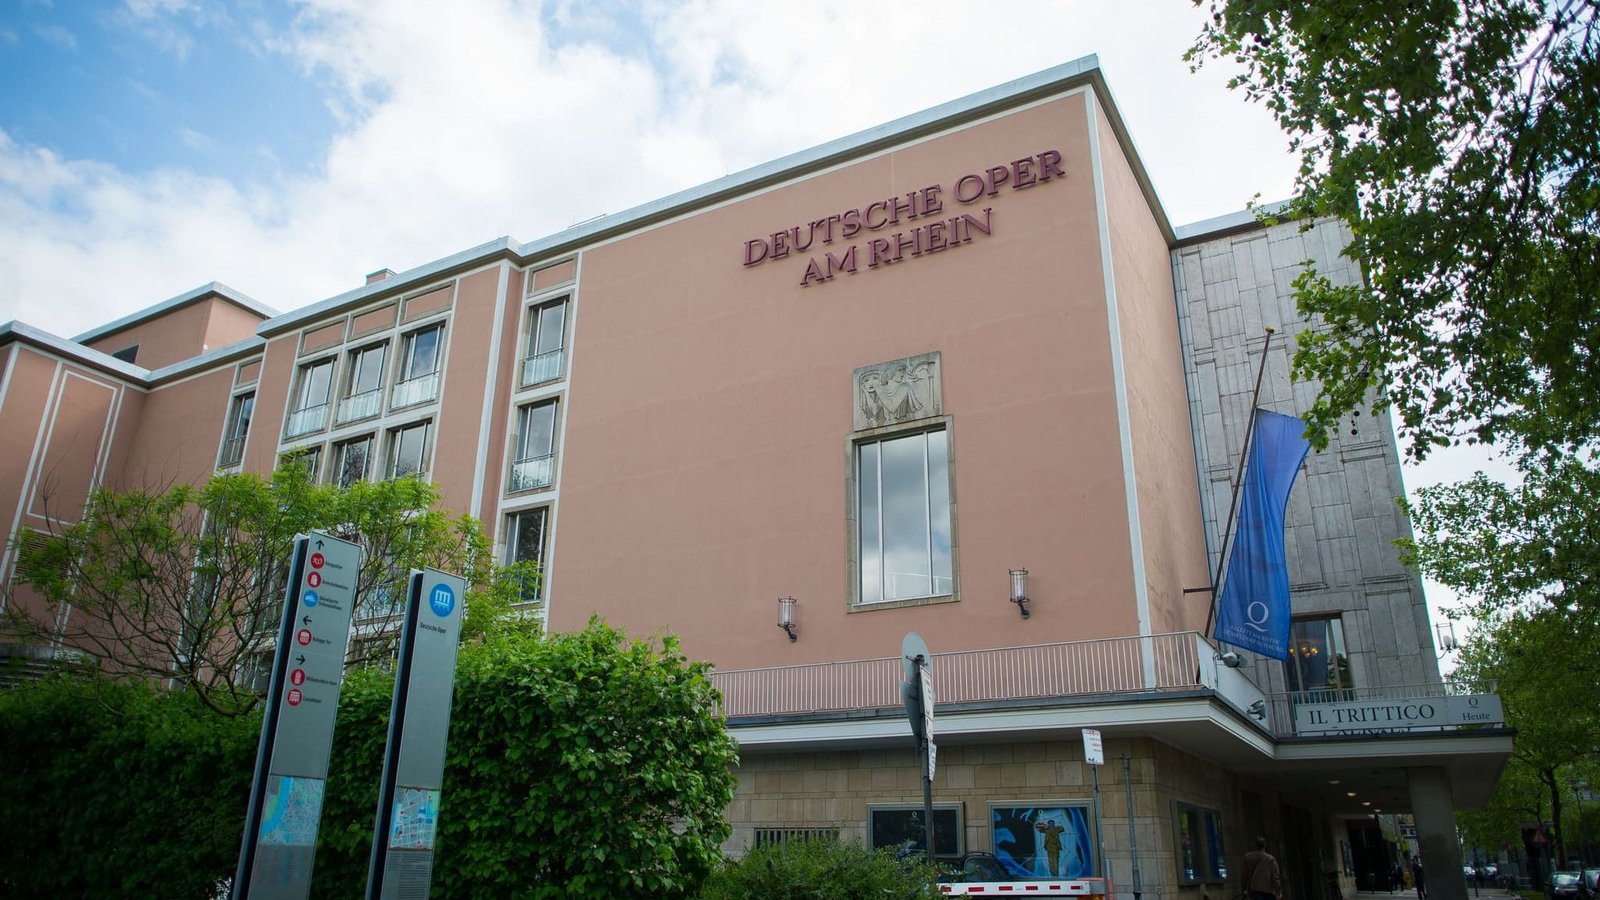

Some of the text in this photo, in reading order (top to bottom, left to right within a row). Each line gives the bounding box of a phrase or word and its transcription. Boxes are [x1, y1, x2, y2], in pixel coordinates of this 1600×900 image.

[743, 150, 1065, 266] DEUTSCHE OPER
[800, 208, 993, 285] AM RHEIN
[1245, 601, 1269, 632] Q
[1309, 704, 1435, 725] IL TRITTICO
[1468, 697, 1480, 708] Q
[1462, 712, 1491, 721] Heute
